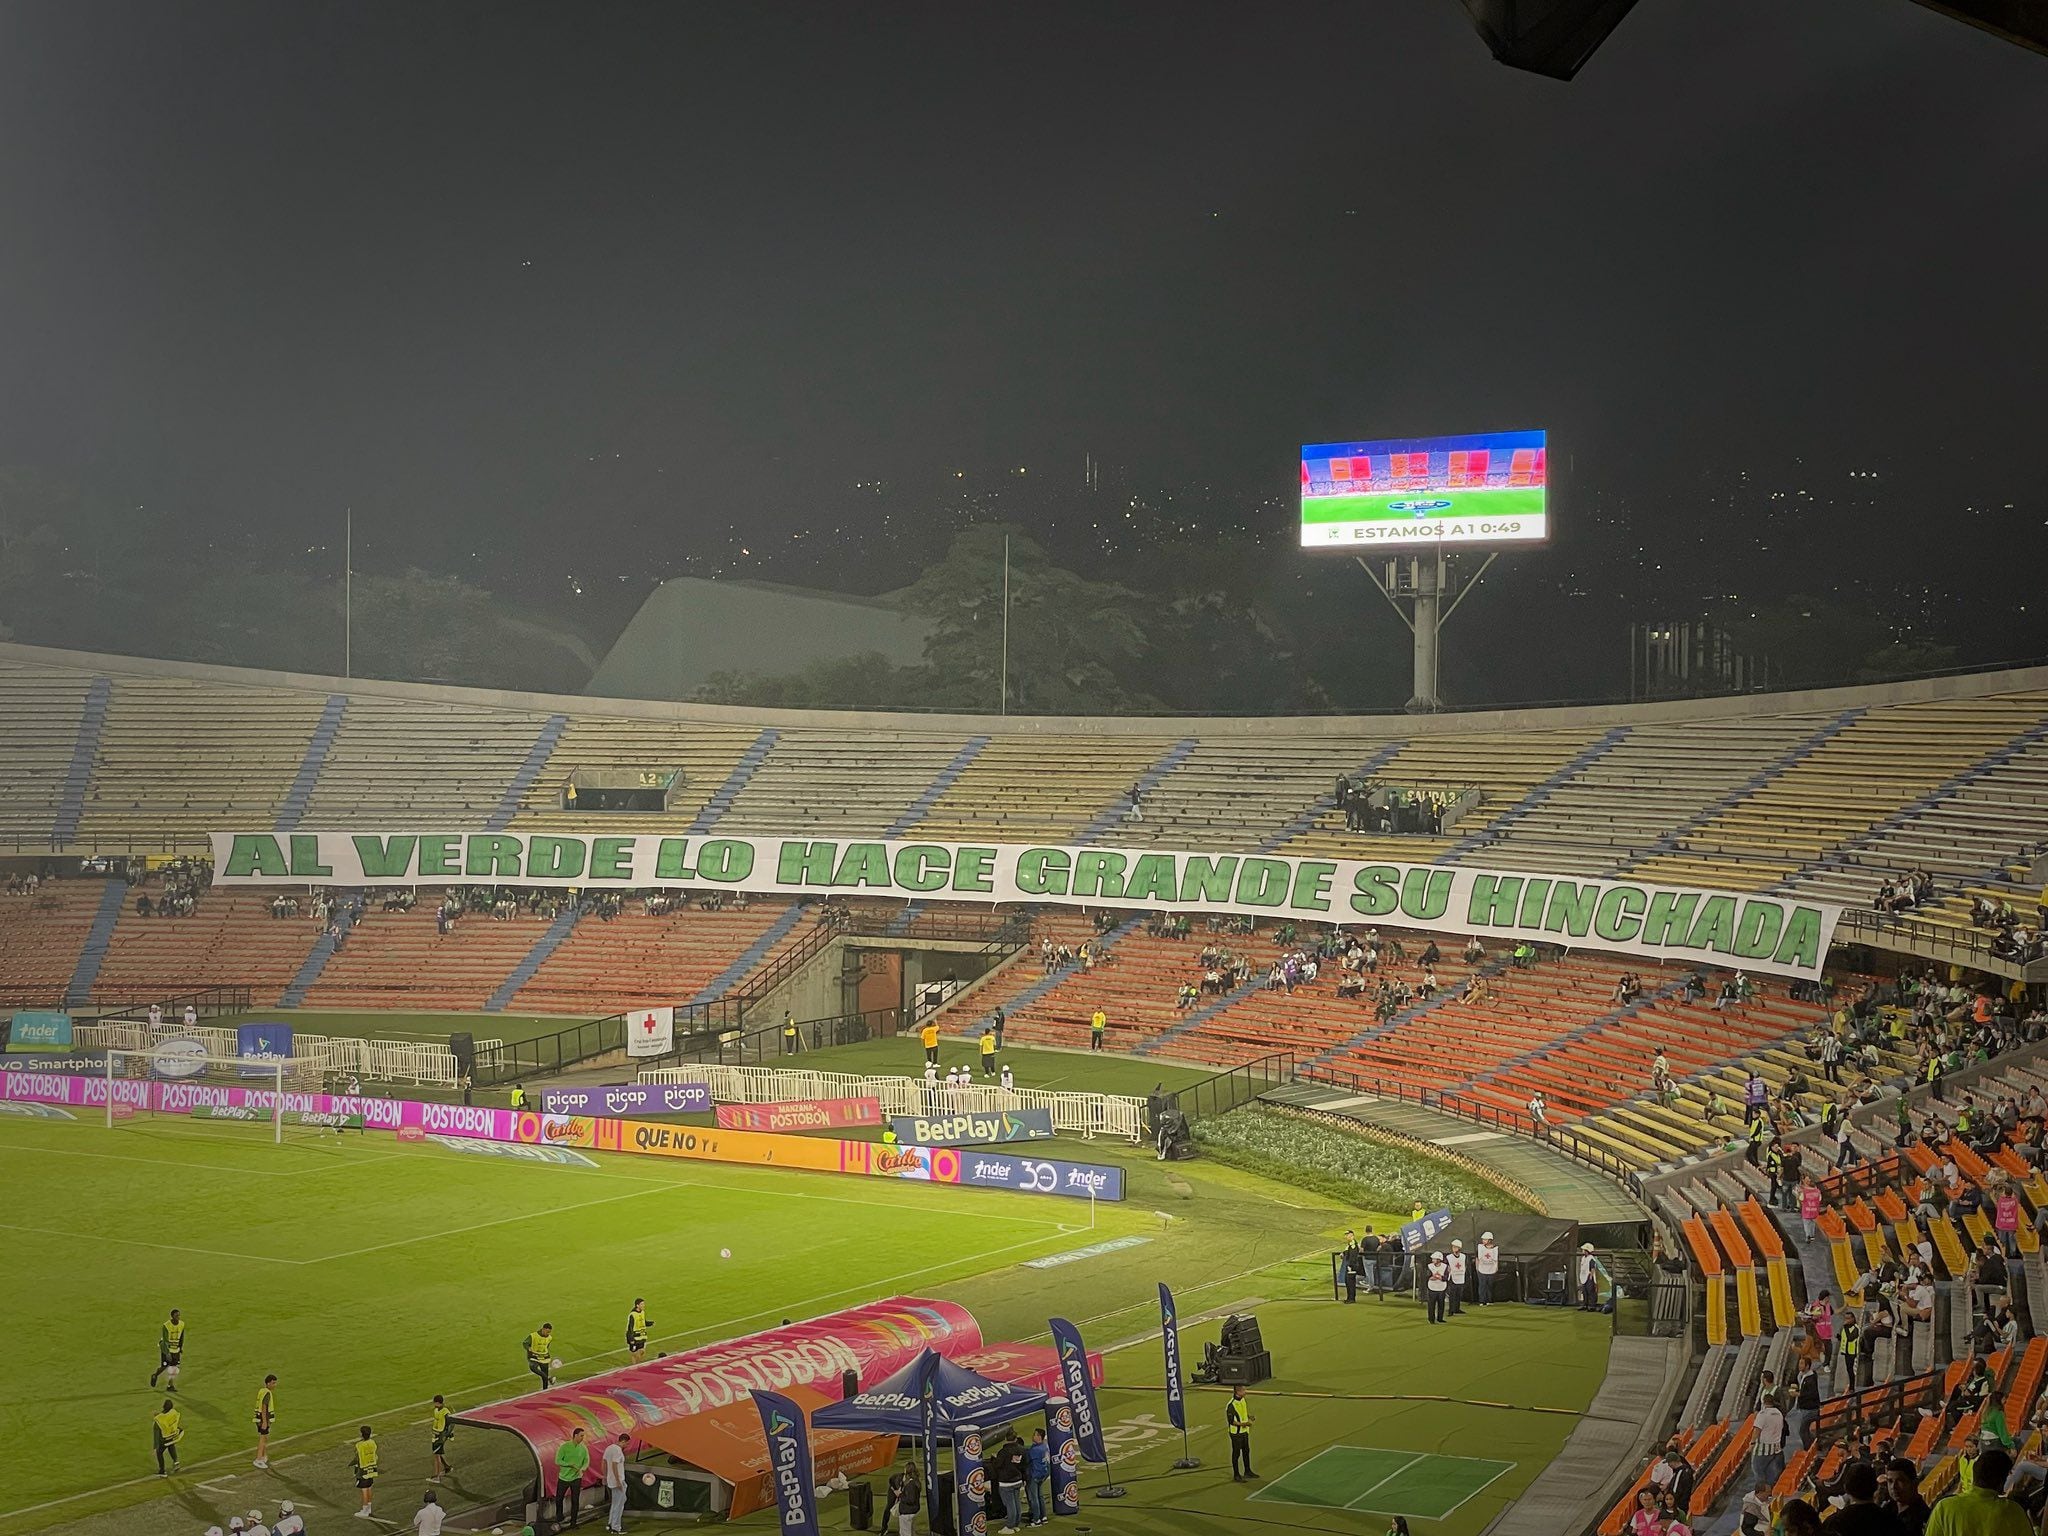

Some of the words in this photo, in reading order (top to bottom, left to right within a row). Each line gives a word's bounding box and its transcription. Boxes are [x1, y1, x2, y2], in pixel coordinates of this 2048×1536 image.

[1354, 524, 1445, 539] ESTAMOS
[223, 834, 333, 877] AL
[352, 835, 636, 880] VERDE
[655, 838, 755, 883] LO
[776, 841, 997, 892] HACE
[1015, 848, 1337, 911] GRANDE
[1350, 865, 1455, 920] SU
[1467, 875, 1822, 968] HINCHADA
[547, 1091, 589, 1109] picap
[606, 1088, 647, 1106] picap
[664, 1086, 705, 1103] picap
[635, 1126, 670, 1150] QUE
[673, 1132, 696, 1151] NO
[914, 1114, 1000, 1142] BetPlay
[852, 1392, 920, 1410] BetPlay
[945, 1381, 1002, 1407] BetPlay
[1067, 1360, 1094, 1438] BetPlay
[777, 1437, 806, 1525] BetPlay
